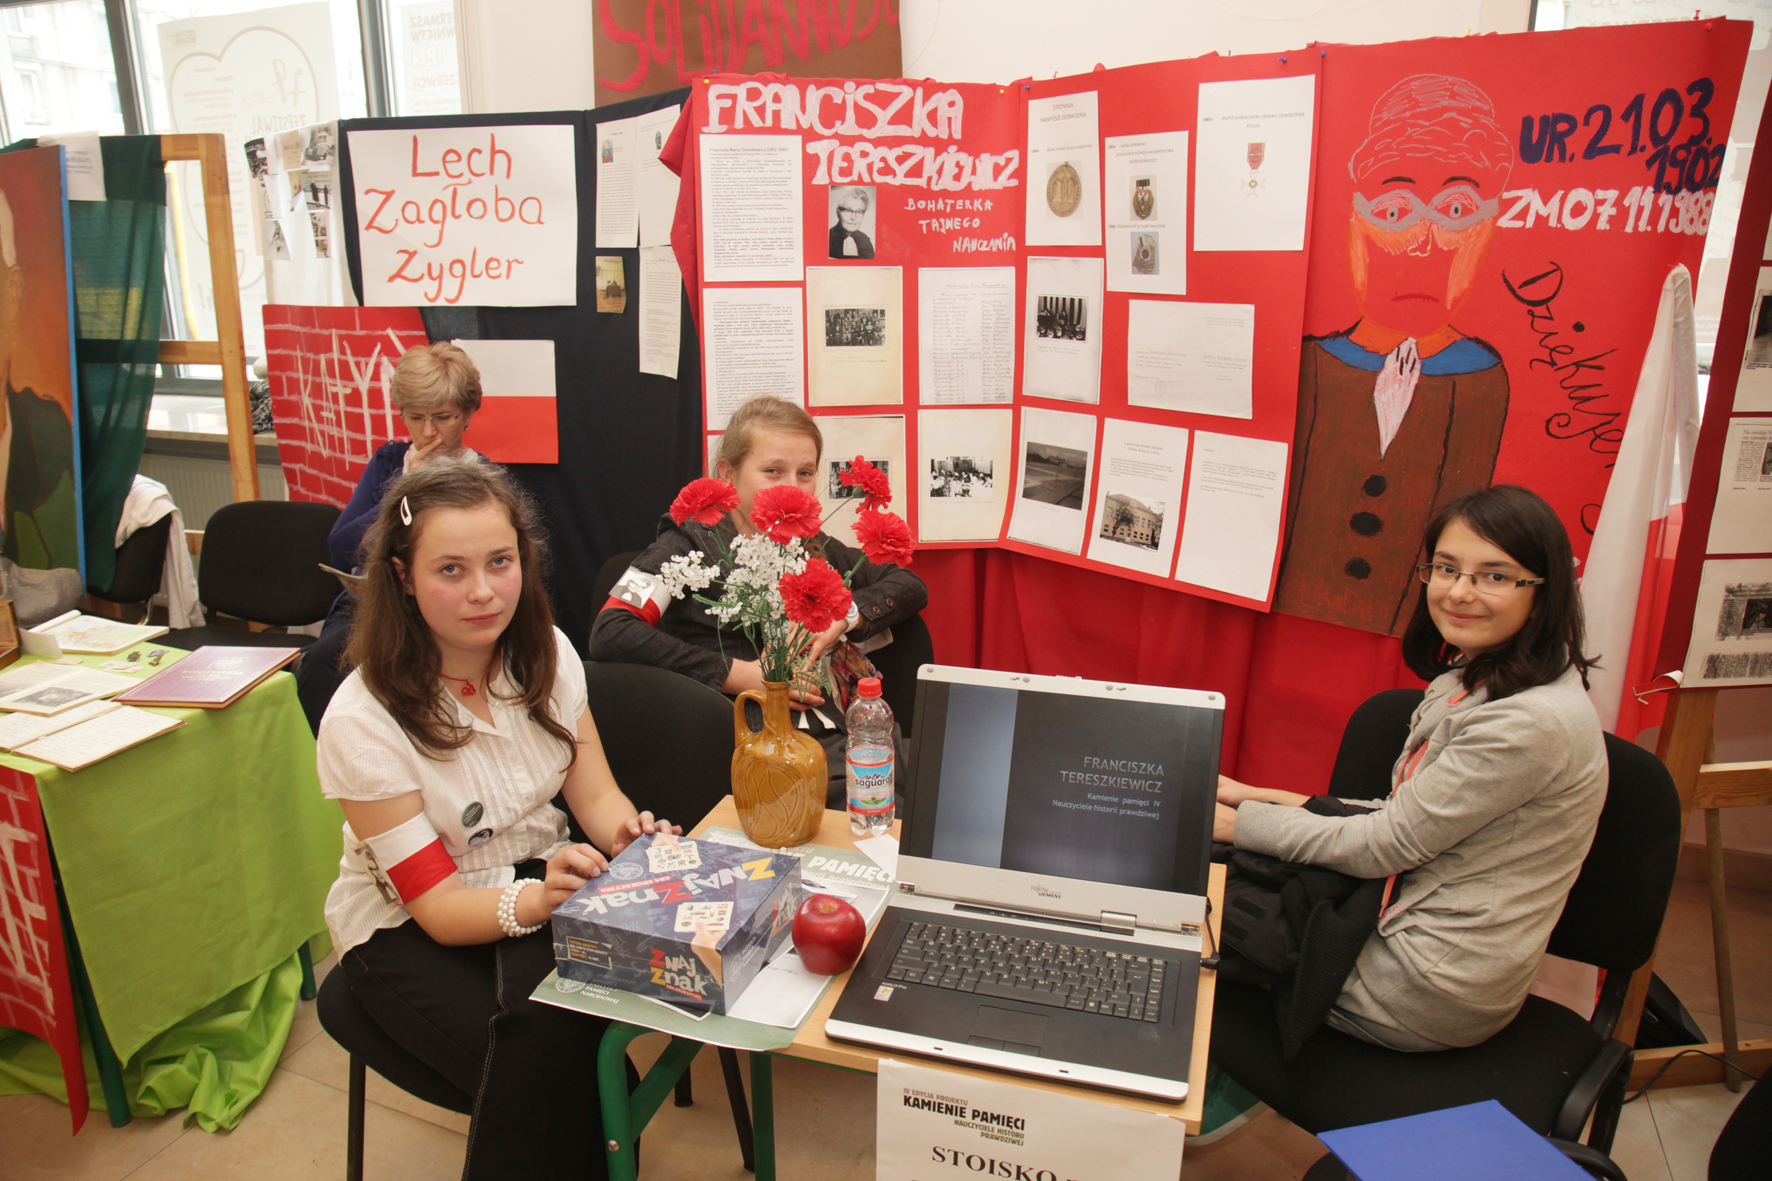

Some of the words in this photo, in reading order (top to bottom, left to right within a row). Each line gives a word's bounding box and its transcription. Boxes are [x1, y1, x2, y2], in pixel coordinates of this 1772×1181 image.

[412, 133, 512, 179] Lech
[1646, 143, 1726, 196] 1902
[904, 198, 994, 212] BOHATERKA
[918, 218, 980, 234] TAJNEGO
[387, 247, 524, 304] Zygler
[1084, 757, 1164, 776] FRANCISZKA
[855, 777, 890, 788] saguaro
[1060, 771, 1162, 793] TERESZKIEWICZ
[1053, 800, 1093, 810] Nauczyciele
[1094, 804, 1118, 814] historii
[1119, 808, 1160, 820] prawdziwej
[1088, 793, 1119, 803] Kamienie
[1122, 798, 1150, 807] pamięci
[912, 1090, 935, 1099] EDYCJA
[936, 1094, 968, 1106] PROJEKTU
[903, 1095, 967, 1119] KAMIENIE
[971, 1109, 1025, 1132] PAMIĘCI
[954, 1119, 995, 1133] NAUCZYCIELE
[997, 1128, 1024, 1139] HISTORII
[981, 1132, 1024, 1146] PRAWDZIWEJ
[932, 1146, 1057, 1181] STOISKO
